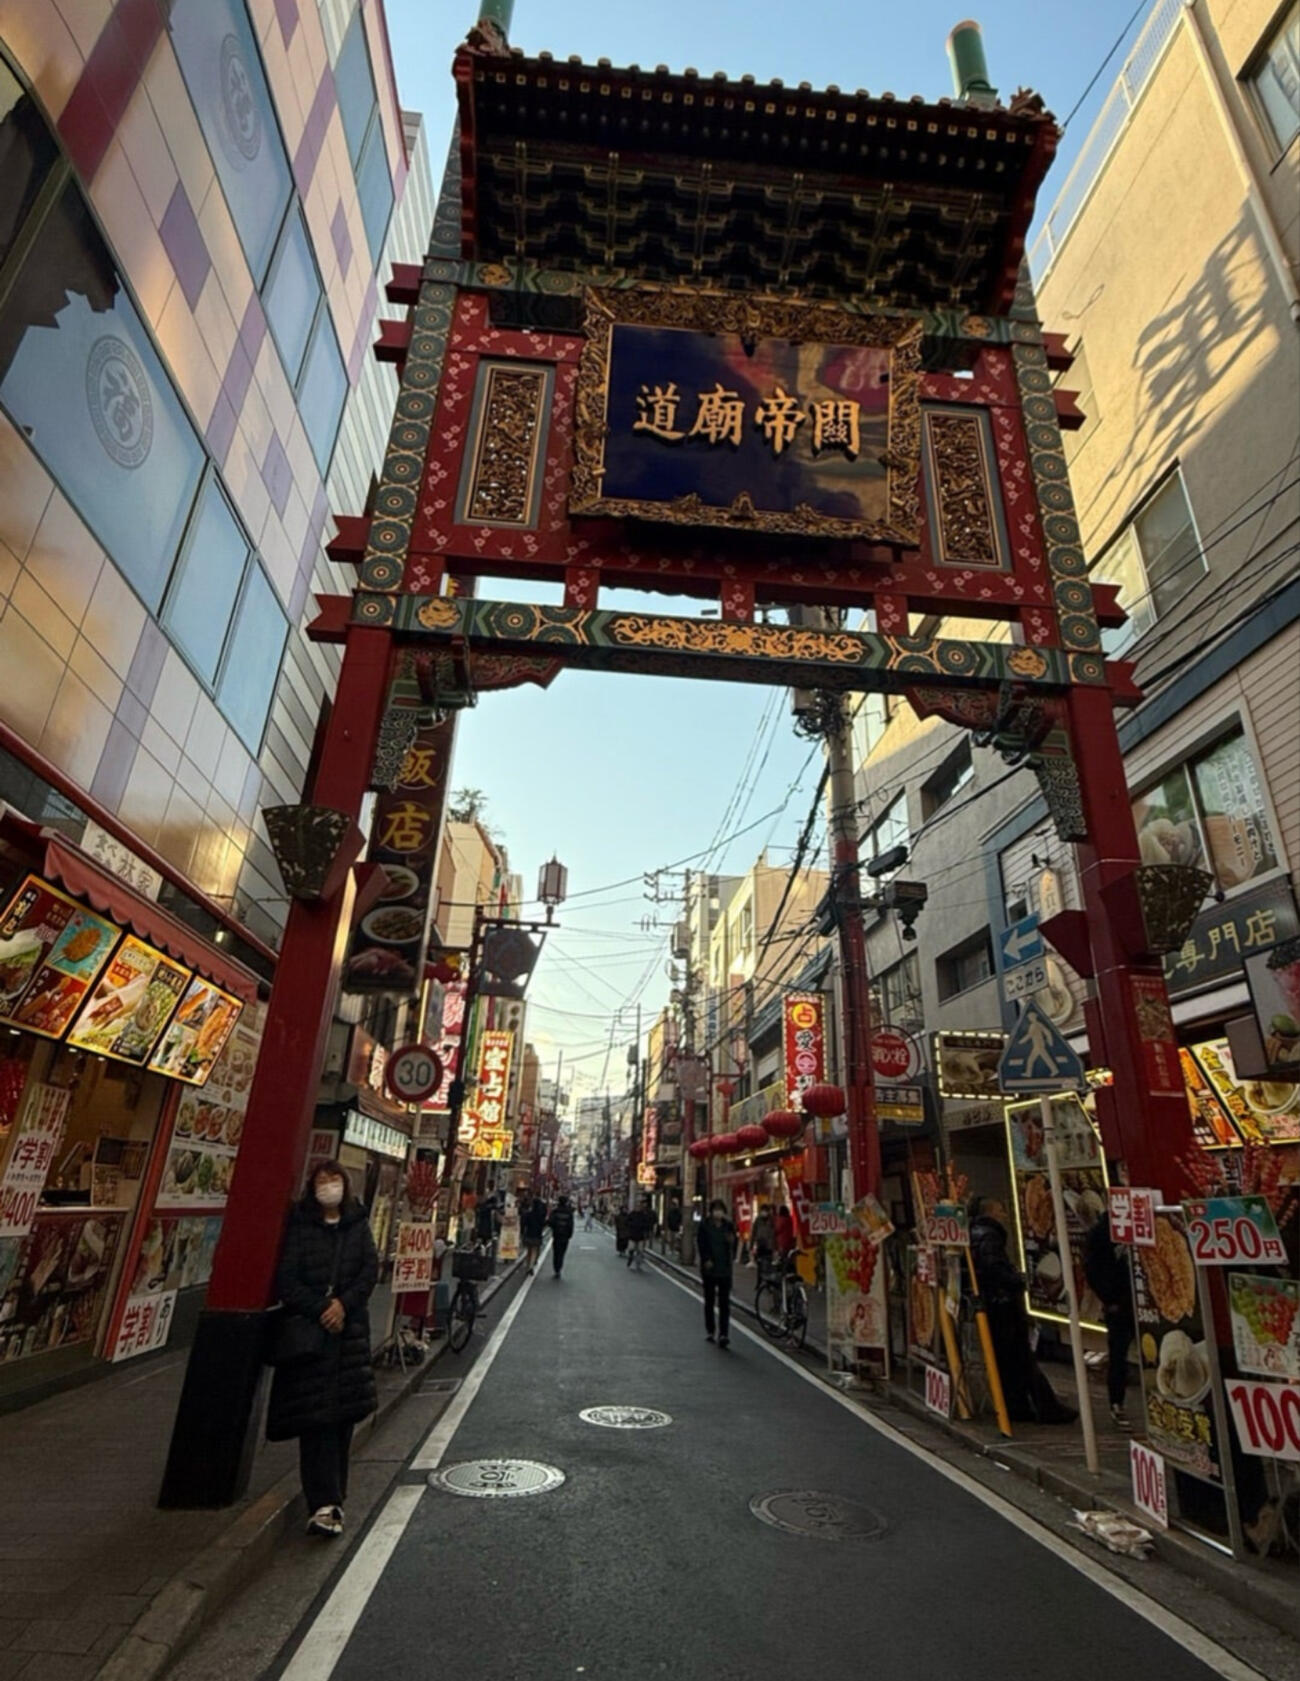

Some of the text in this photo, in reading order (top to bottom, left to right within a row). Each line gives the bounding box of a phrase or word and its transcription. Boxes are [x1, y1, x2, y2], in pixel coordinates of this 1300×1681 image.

[1161, 908, 1277, 981] 専門店
[1006, 967, 1045, 994] ここから
[398, 1059, 432, 1087] 30
[5, 1190, 36, 1226] 400
[1111, 1193, 1153, 1240] 学割
[407, 1228, 433, 1253] 400
[1190, 1218, 1282, 1259] 250円
[926, 1370, 944, 1412] 100
[1231, 1385, 1300, 1453] 100
[1132, 1446, 1159, 1514] 100
